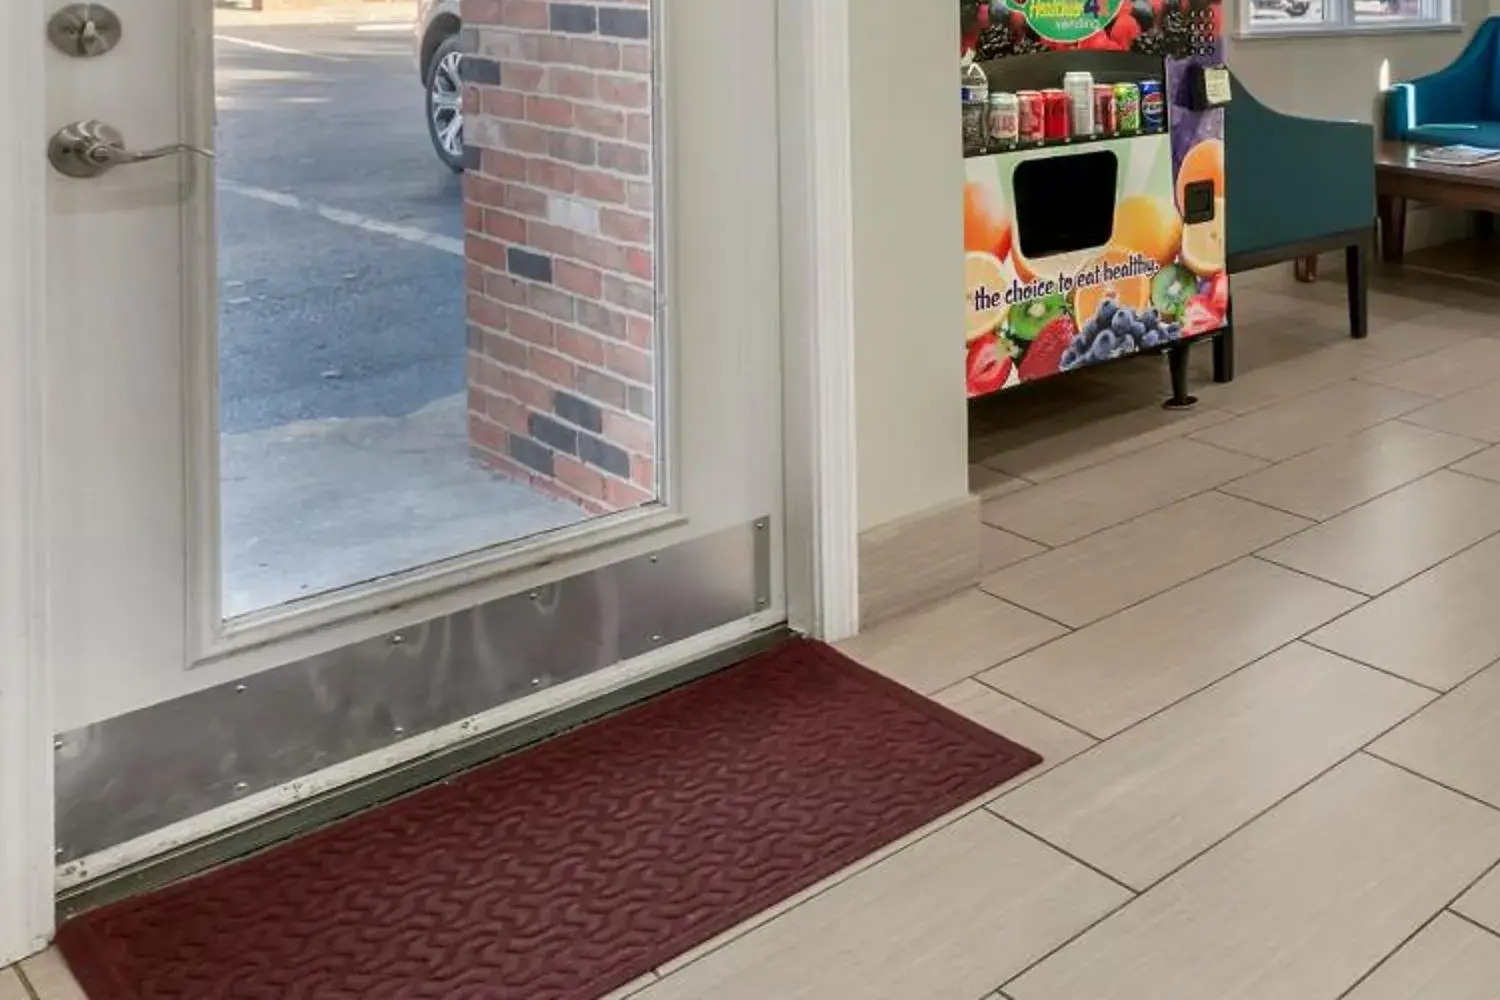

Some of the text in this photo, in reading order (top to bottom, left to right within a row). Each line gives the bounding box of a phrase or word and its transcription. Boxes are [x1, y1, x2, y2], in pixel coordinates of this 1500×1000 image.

[974, 286, 1001, 311] the
[1005, 279, 1056, 304] choice
[1059, 272, 1073, 292] to
[1077, 265, 1100, 288] eat
